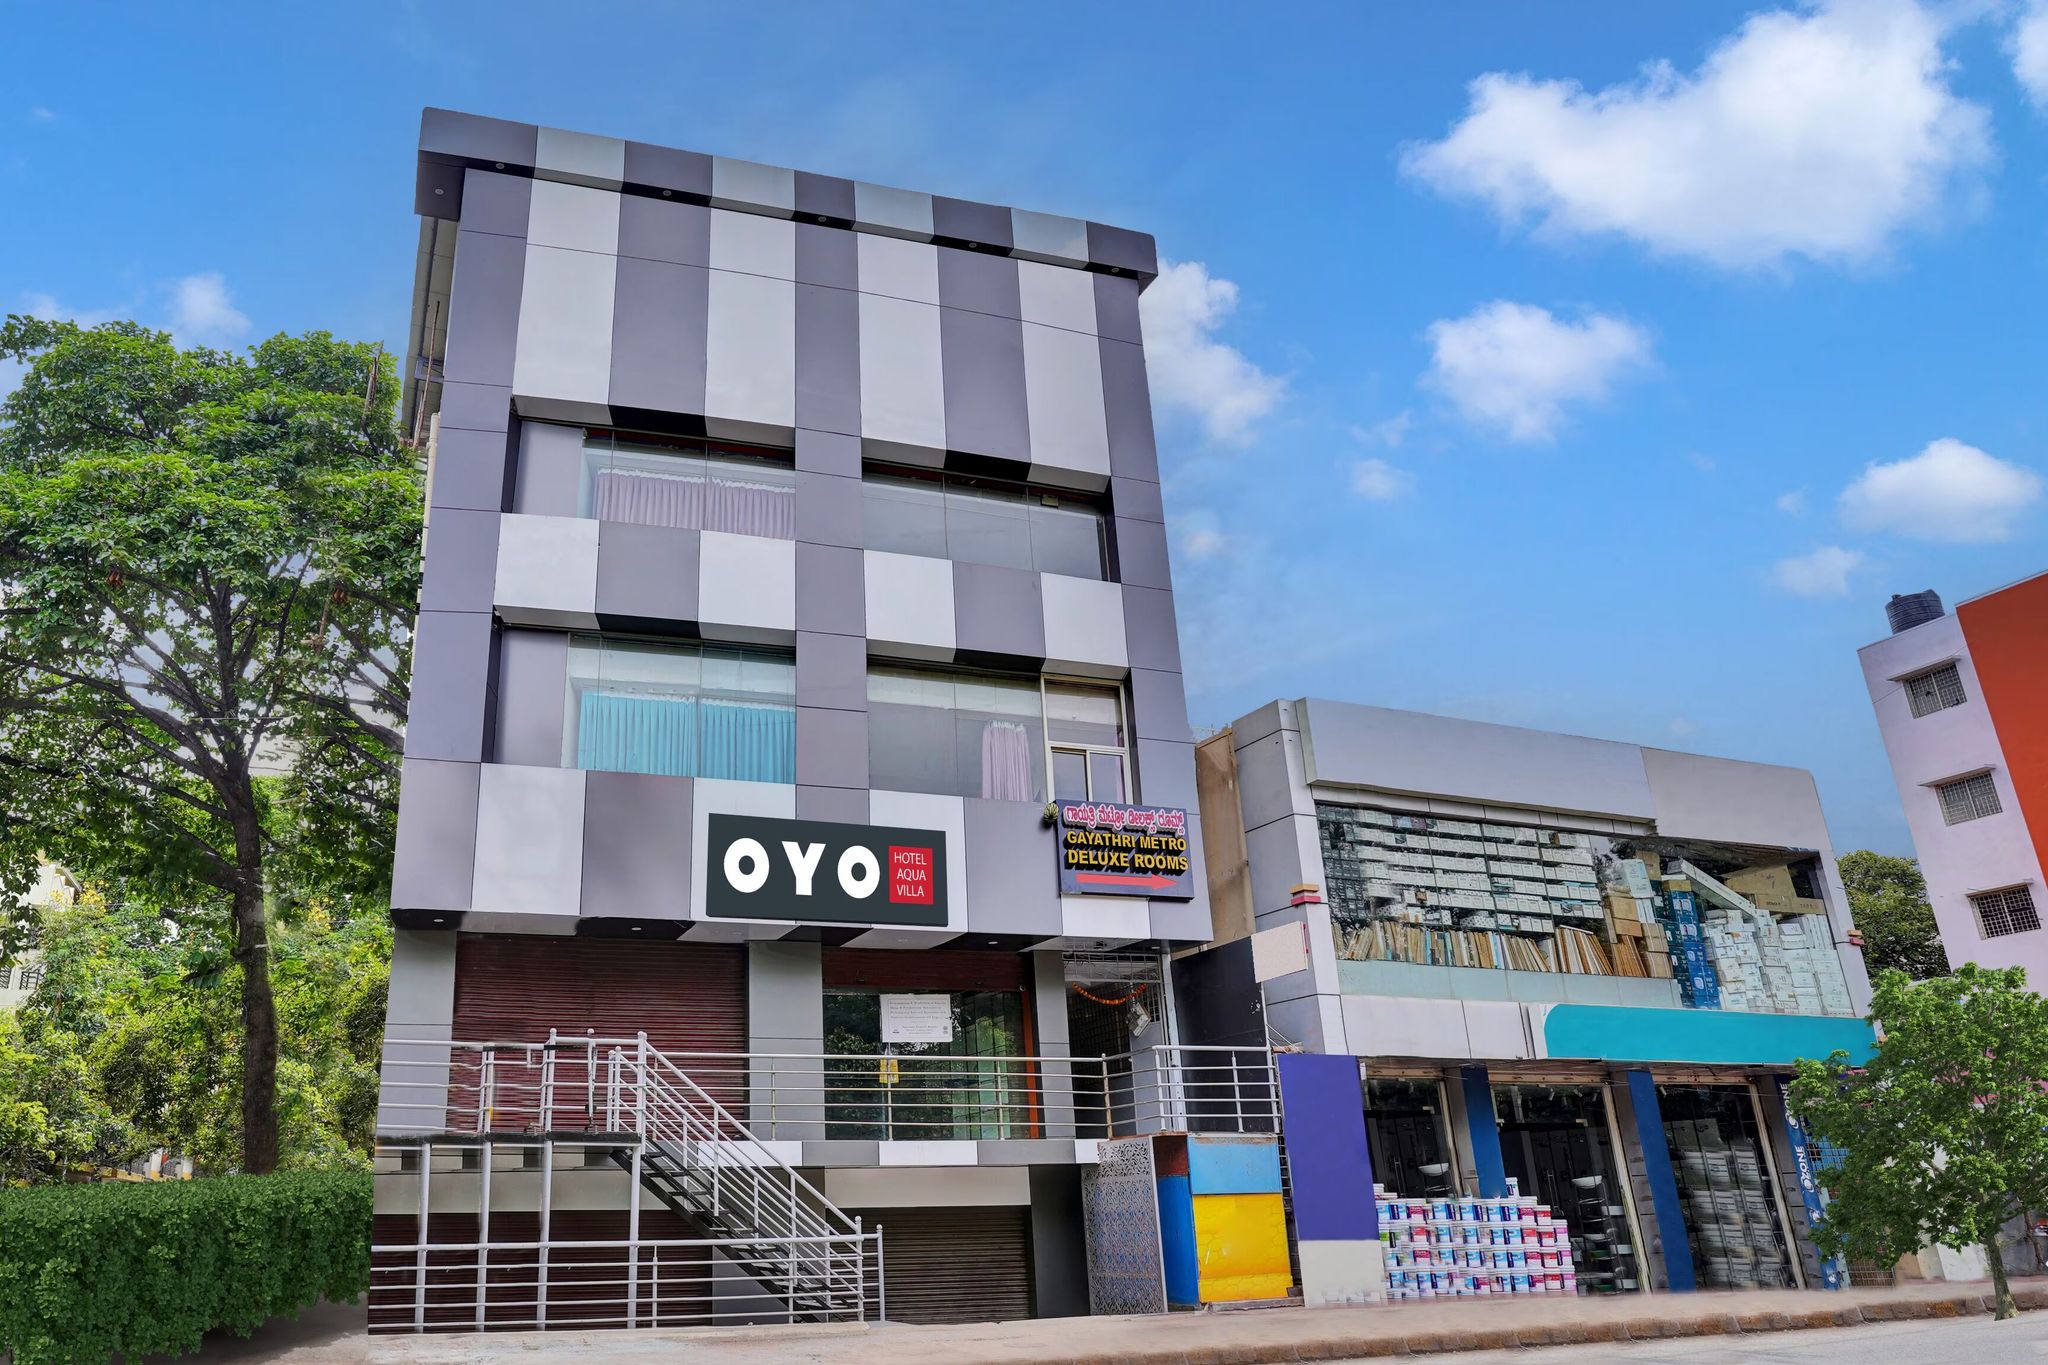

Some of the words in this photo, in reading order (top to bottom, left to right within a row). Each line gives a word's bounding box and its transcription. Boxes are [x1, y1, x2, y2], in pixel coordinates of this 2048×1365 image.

[1067, 831, 1136, 848] GAYATHRI
[1139, 836, 1187, 851] METRO
[894, 851, 928, 865] HOTEL
[1067, 849, 1130, 867] DELUXE
[1133, 854, 1189, 871] ROOMS
[724, 838, 880, 899] OYO
[896, 868, 927, 882] AQUA
[896, 884, 925, 897] VILLA
[1794, 1145, 1815, 1193] OZONE
